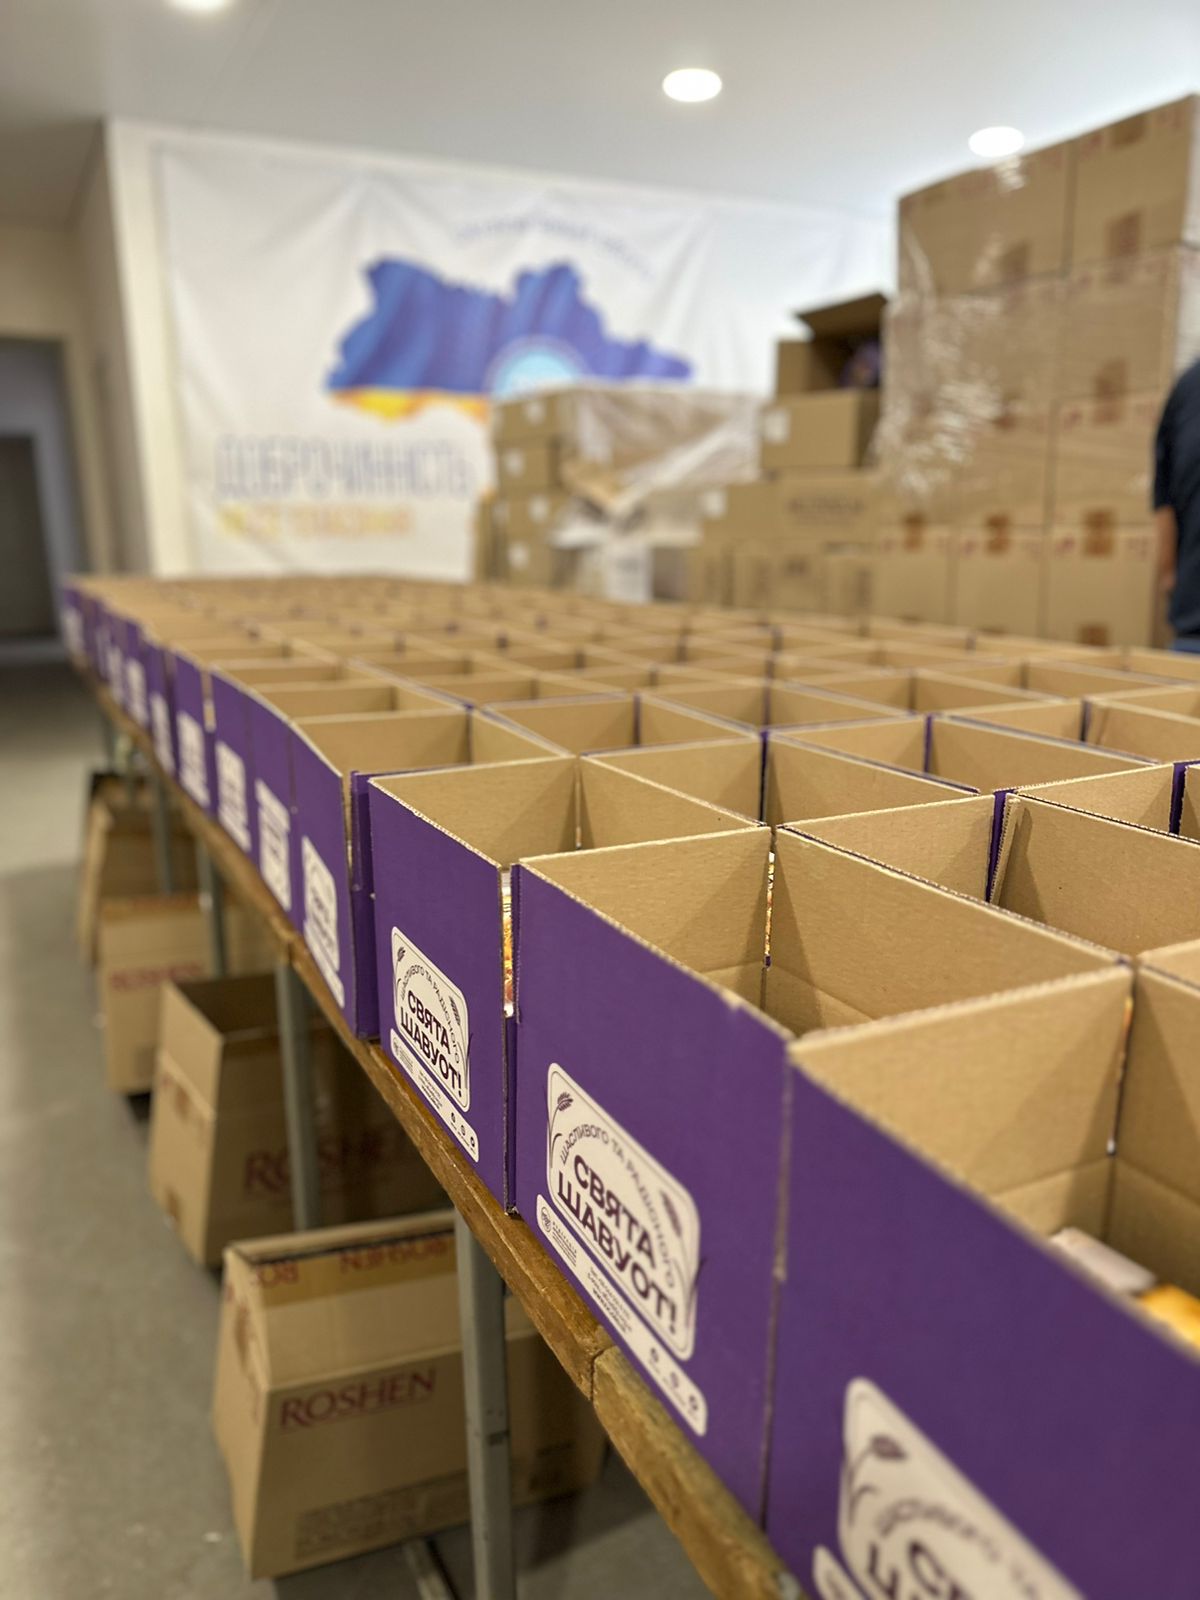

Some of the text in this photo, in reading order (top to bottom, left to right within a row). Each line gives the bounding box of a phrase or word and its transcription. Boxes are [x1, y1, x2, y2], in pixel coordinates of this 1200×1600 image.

[400, 1006, 462, 1098] ШАВУОТ!
[407, 989, 451, 1055] СВЯТА
[560, 1124, 609, 1165] ЩАСЛИВОГО
[573, 1154, 656, 1270] СВЯТА
[557, 1170, 677, 1335] ШАВУОТ!
[280, 1366, 437, 1429] ROSHEN
